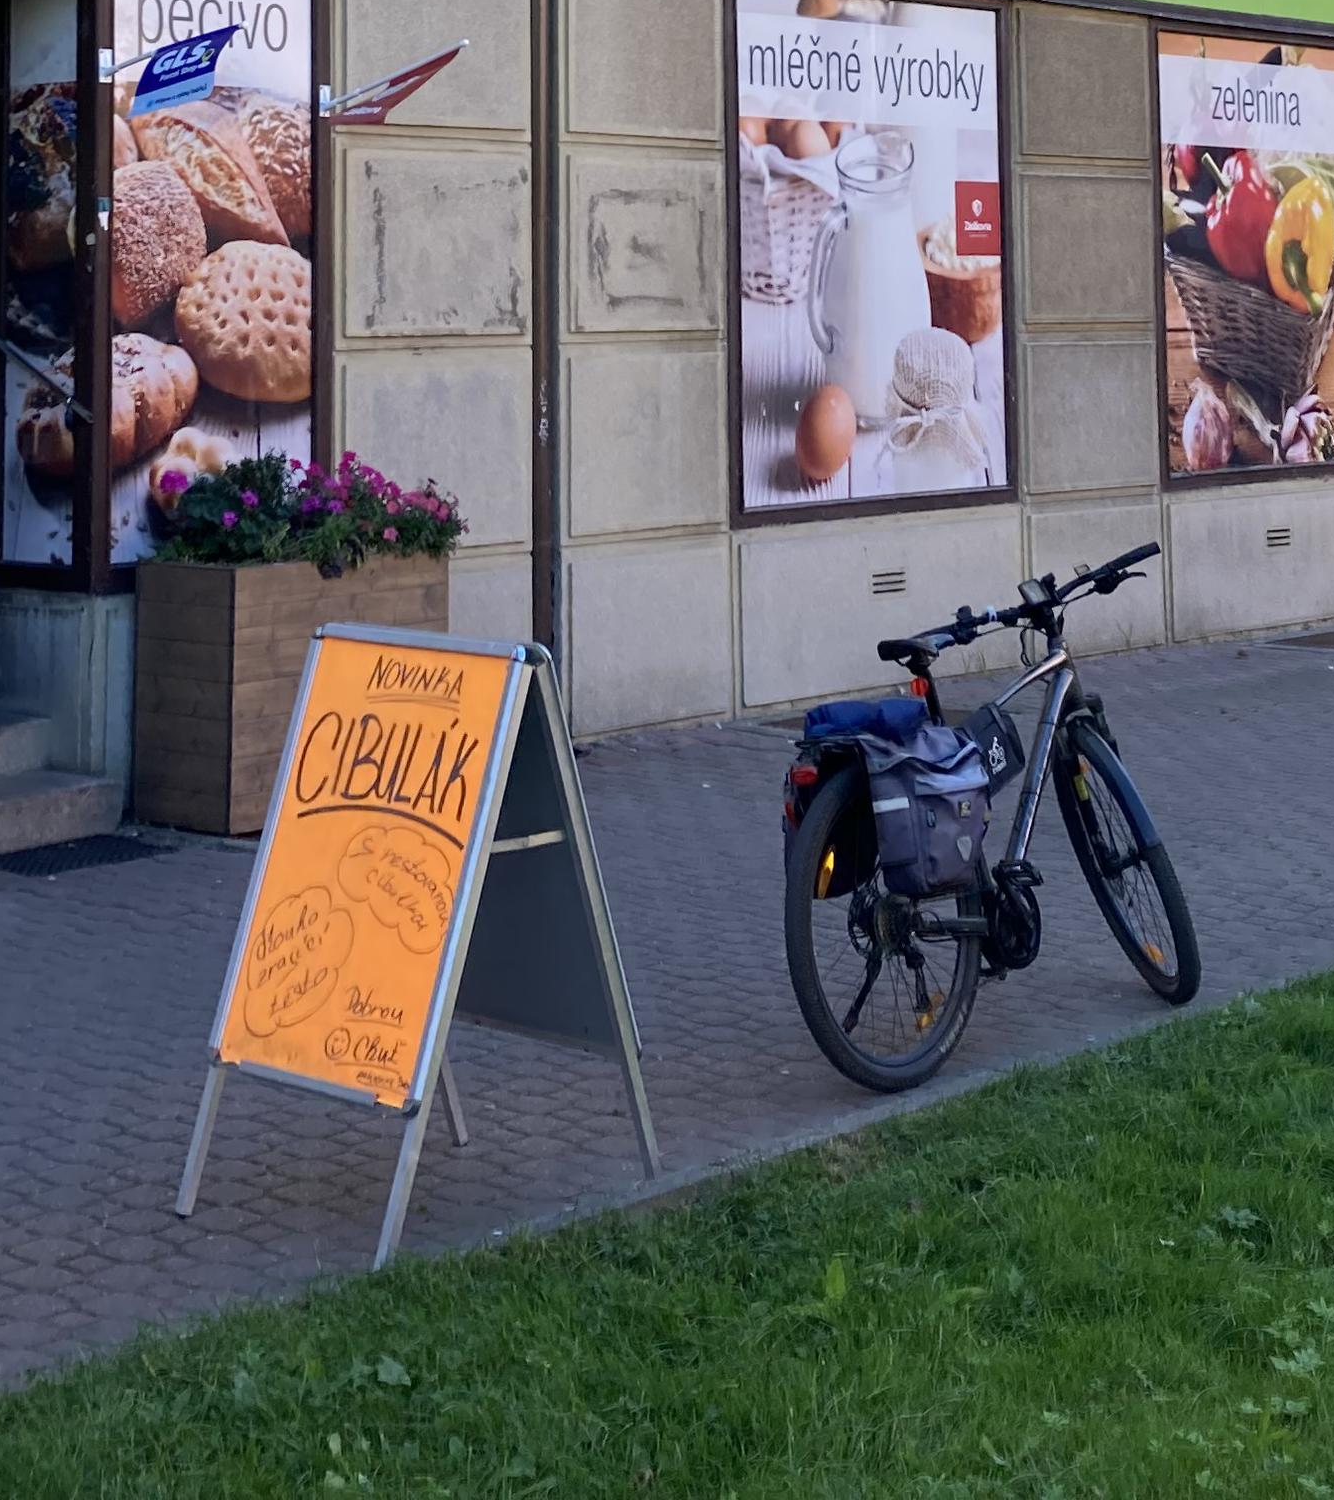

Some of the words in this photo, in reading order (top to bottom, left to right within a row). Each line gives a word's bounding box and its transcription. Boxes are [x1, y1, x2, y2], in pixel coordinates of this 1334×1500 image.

[152, 40, 211, 74] GLS
[749, 34, 861, 93] mléčné
[874, 43, 984, 112] výrobky
[1211, 77, 1301, 126] zelenina
[367, 655, 465, 699] NOVINKA
[296, 712, 479, 822] CIBULÁK
